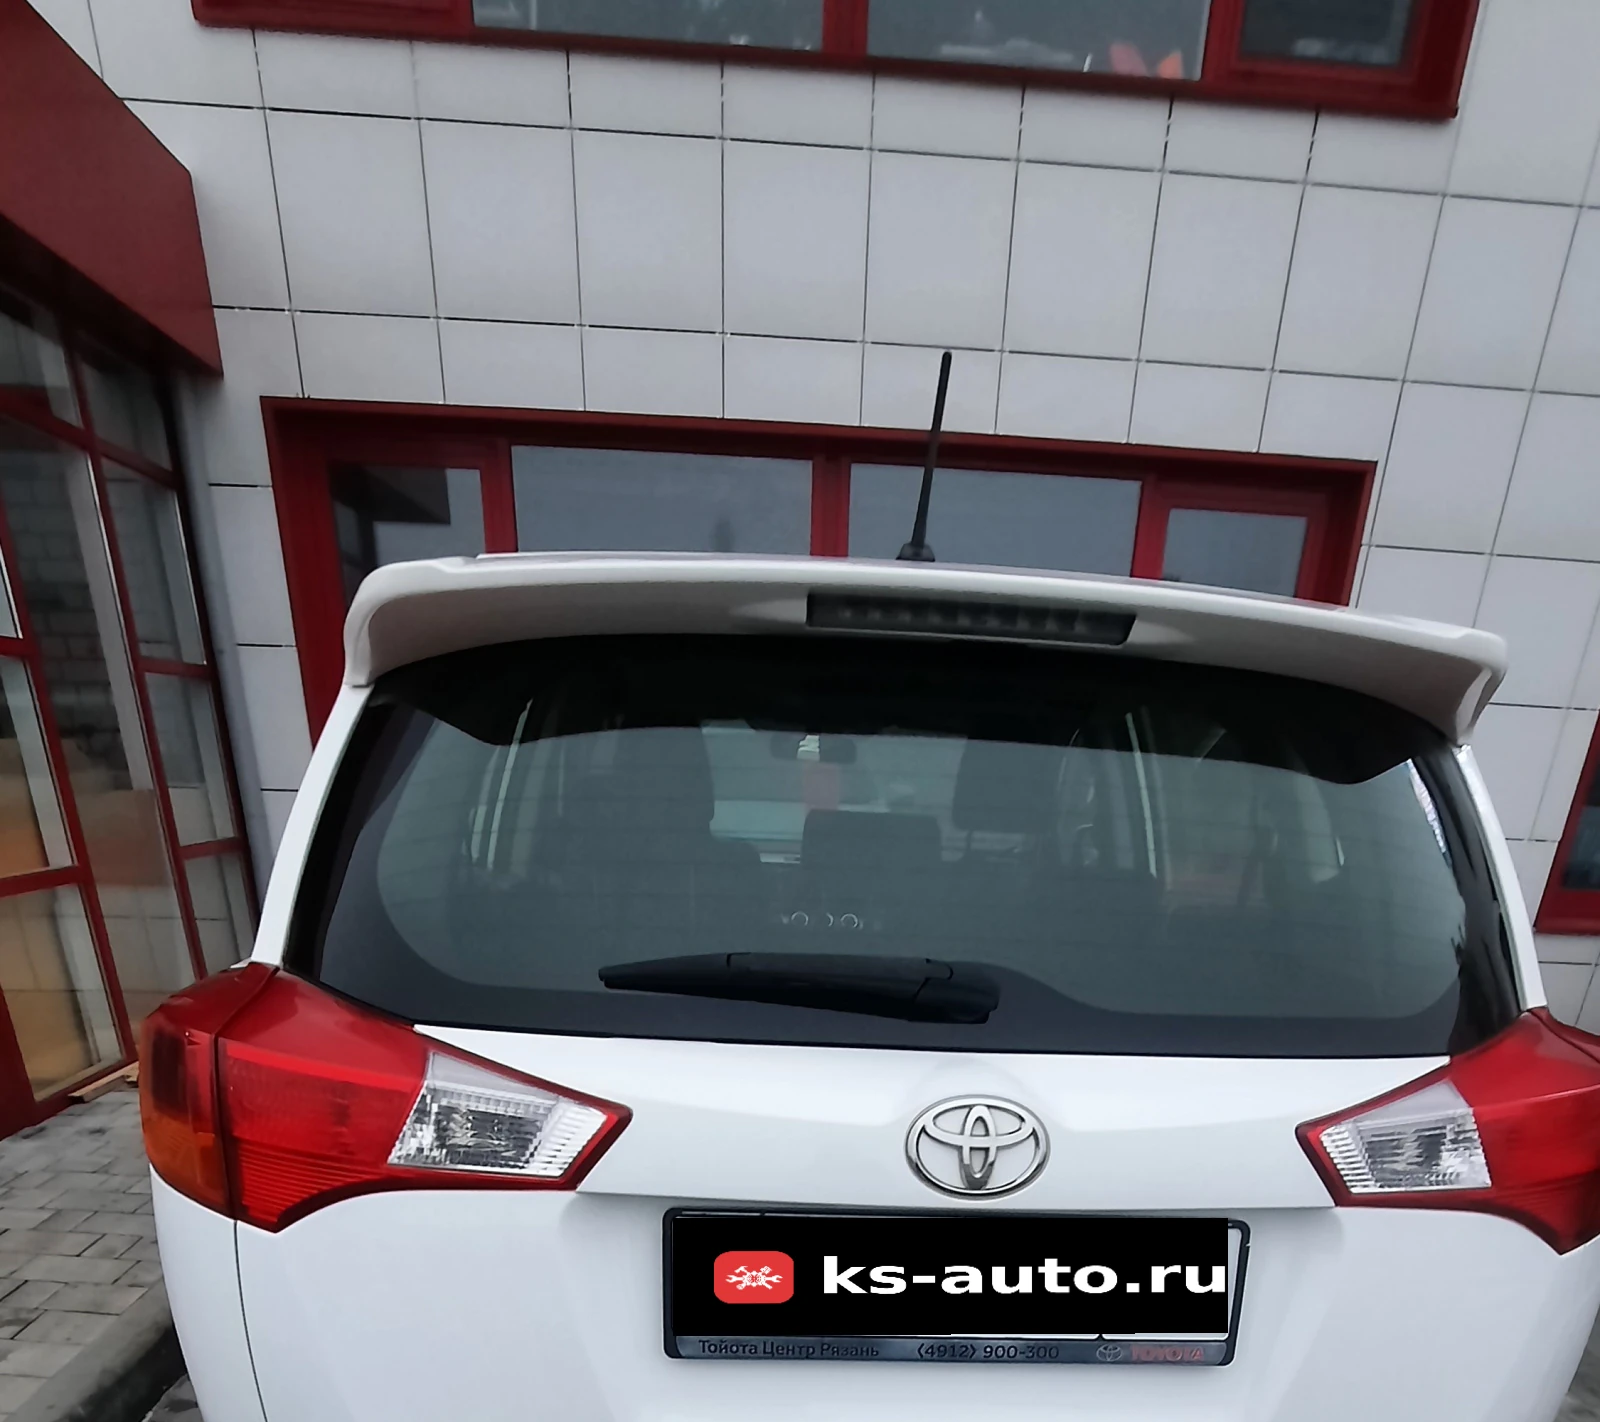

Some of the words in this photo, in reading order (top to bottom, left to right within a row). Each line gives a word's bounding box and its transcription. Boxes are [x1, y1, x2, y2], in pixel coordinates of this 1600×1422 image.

[699, 1339, 758, 1356] Тойота
[762, 1341, 815, 1360] Центр
[820, 1342, 879, 1358] Рязань
[982, 1345, 1060, 1361] 900-300
[1131, 1345, 1204, 1361] TOYOTA
